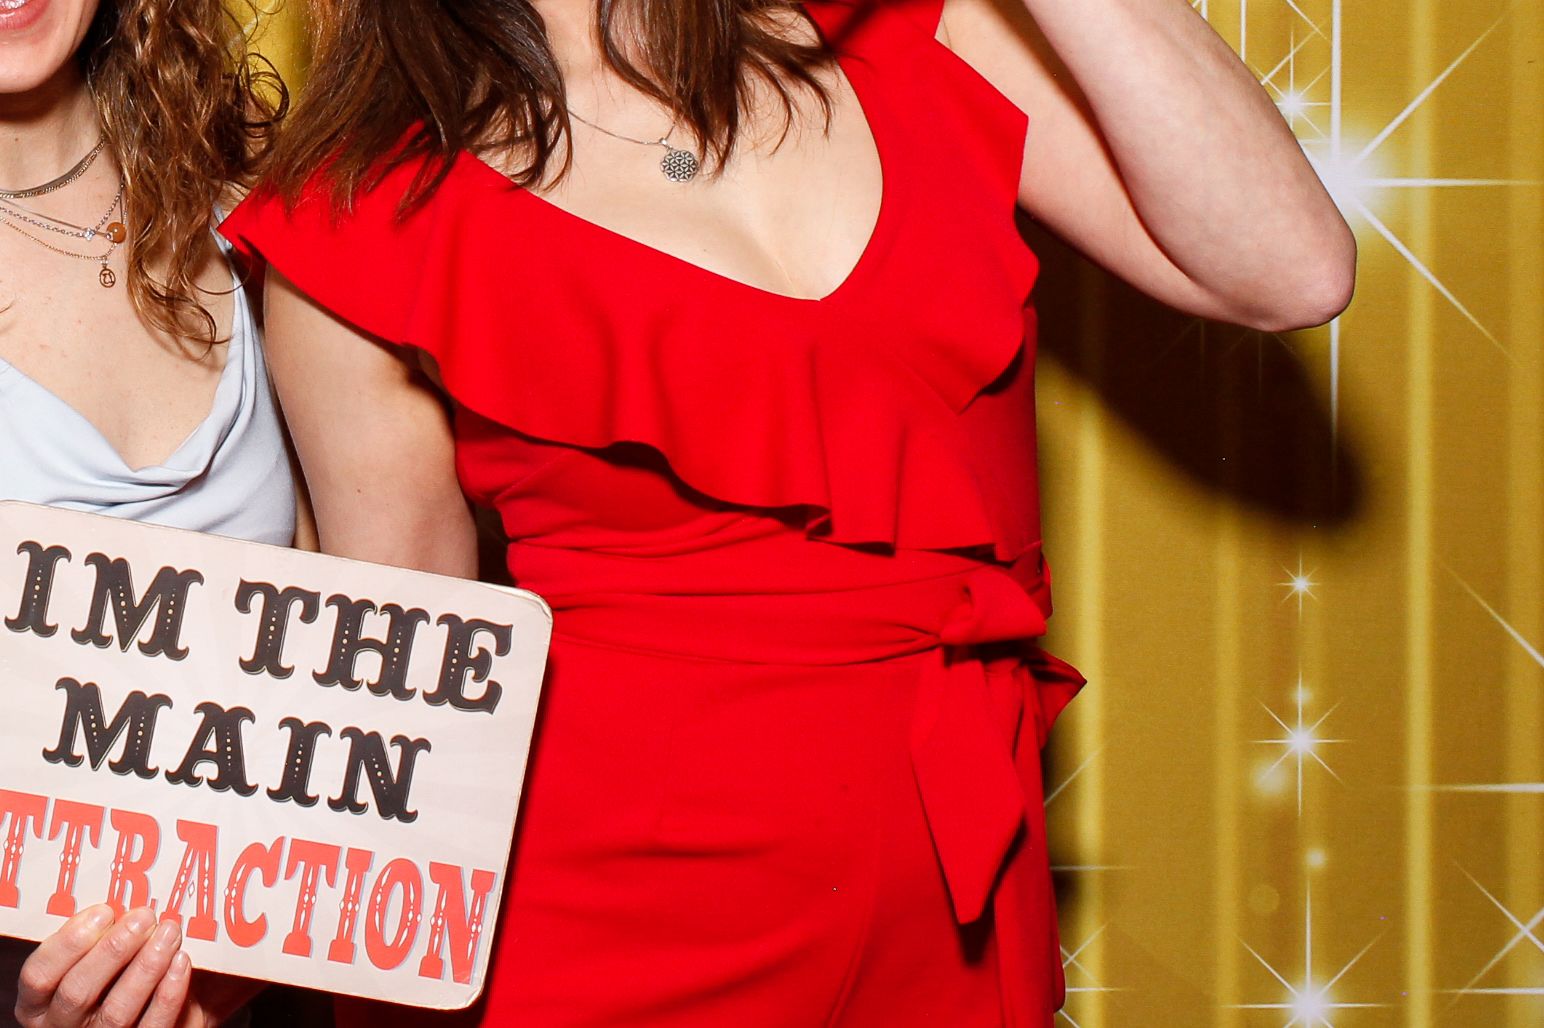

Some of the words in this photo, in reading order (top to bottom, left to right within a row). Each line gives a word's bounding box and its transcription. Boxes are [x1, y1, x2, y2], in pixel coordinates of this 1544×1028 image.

[4, 540, 205, 661] IM
[233, 577, 513, 715] THE
[42, 676, 432, 823] MAIN
